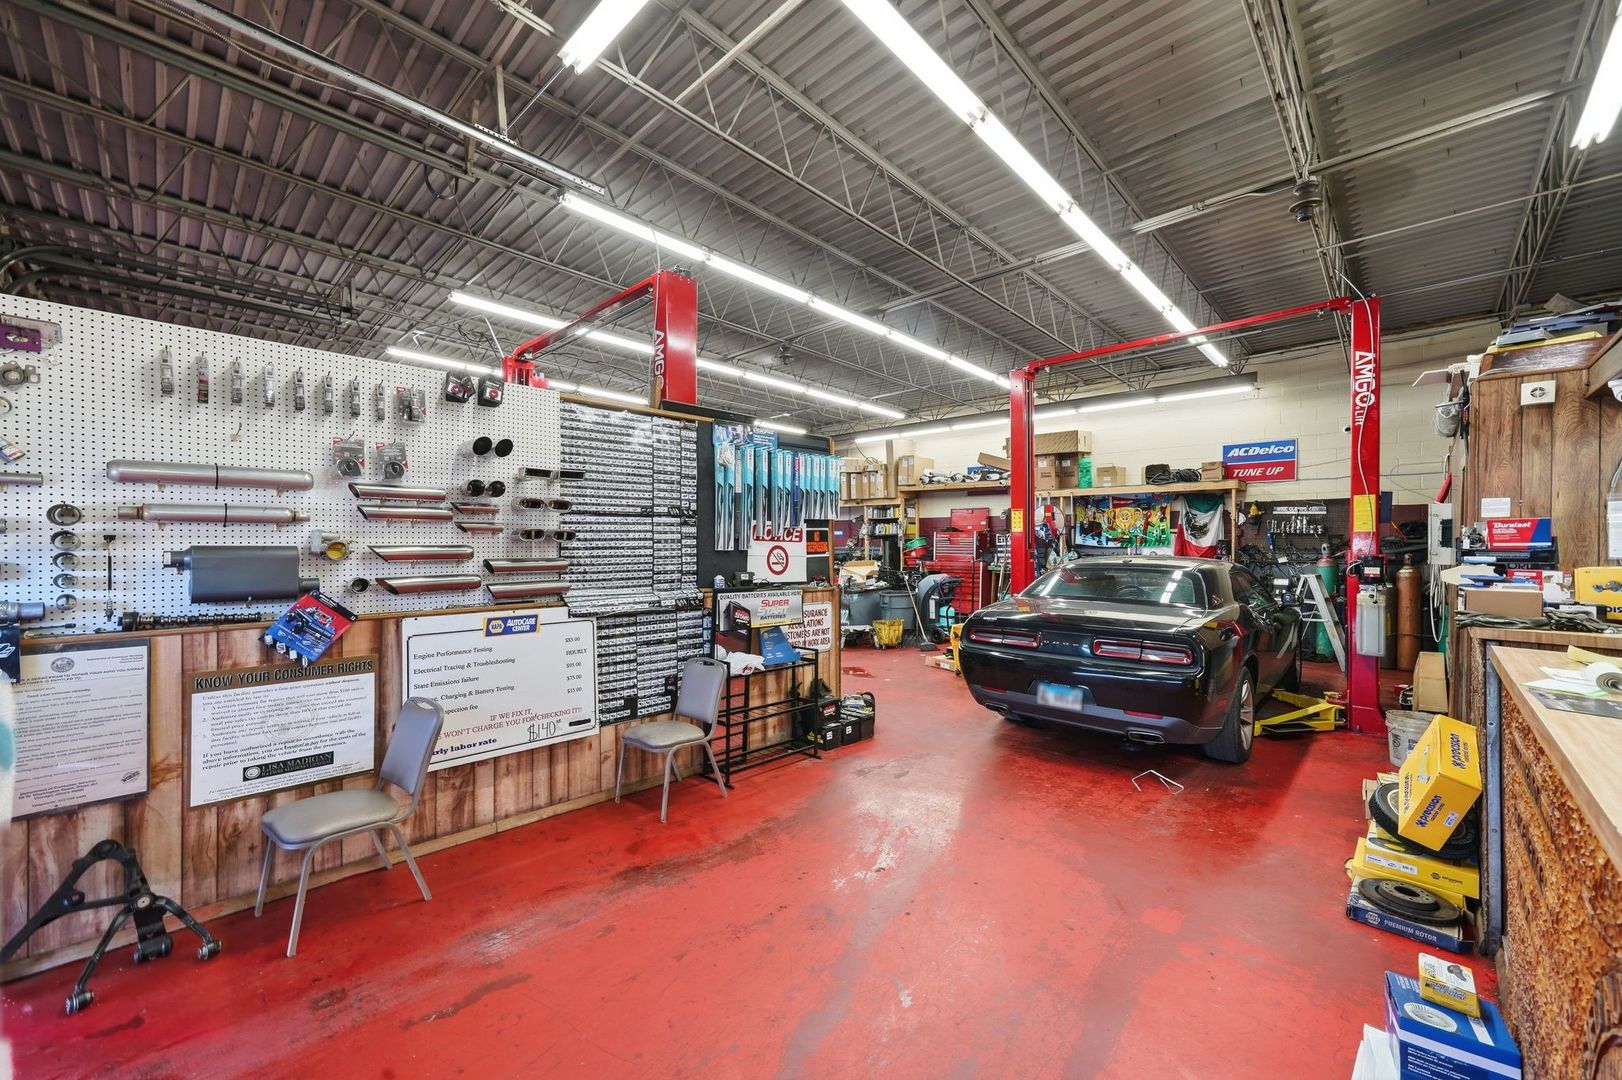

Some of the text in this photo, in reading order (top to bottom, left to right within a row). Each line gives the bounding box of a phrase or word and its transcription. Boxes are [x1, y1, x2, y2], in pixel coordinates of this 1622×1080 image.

[1227, 445, 1295, 458] ACDelco
[1233, 466, 1284, 477] TUNE UP
[762, 599, 790, 608] SUPER
[757, 607, 789, 616] START
[804, 608, 828, 618] SURANCE
[812, 629, 821, 637] ARE
[821, 628, 830, 636] NOT
[808, 639, 820, 647] WORK
[820, 637, 831, 645] AREA
[414, 653, 435, 661] Engine
[436, 649, 472, 657] Performance
[566, 648, 588, 656] HOURLY
[414, 666, 442, 675] Electrical
[444, 664, 465, 672] Tracing
[474, 658, 516, 667] Troubleshooting
[195, 676, 233, 691] KNOW
[239, 671, 270, 686] YOUR
[274, 664, 334, 682] CONSUMER
[337, 660, 373, 674] RIGHTS
[430, 678, 461, 688] Emissions
[461, 676, 480, 684] failure
[440, 692, 468, 701] Charging
[475, 688, 496, 696] Battery
[445, 706, 469, 715] spection
[511, 710, 524, 718] FIX
[444, 728, 471, 739] WON'T
[472, 721, 504, 733] CHARGE
[506, 719, 521, 727] YOU
[523, 716, 536, 724] FOR
[537, 709, 571, 721] CHECKING
[210, 751, 223, 759] you
[240, 743, 272, 753] authorized
[279, 739, 296, 747] repair
[303, 733, 334, 741] accordance
[451, 743, 478, 752] labor
[479, 738, 498, 746] rate
[203, 763, 222, 771] repair
[278, 750, 298, 758] vehicle
[223, 752, 260, 761] information,
[262, 763, 284, 773] LISA
[287, 754, 333, 767] MADIGAN
[1384, 919, 1438, 942] PREMIUM ROTOR
